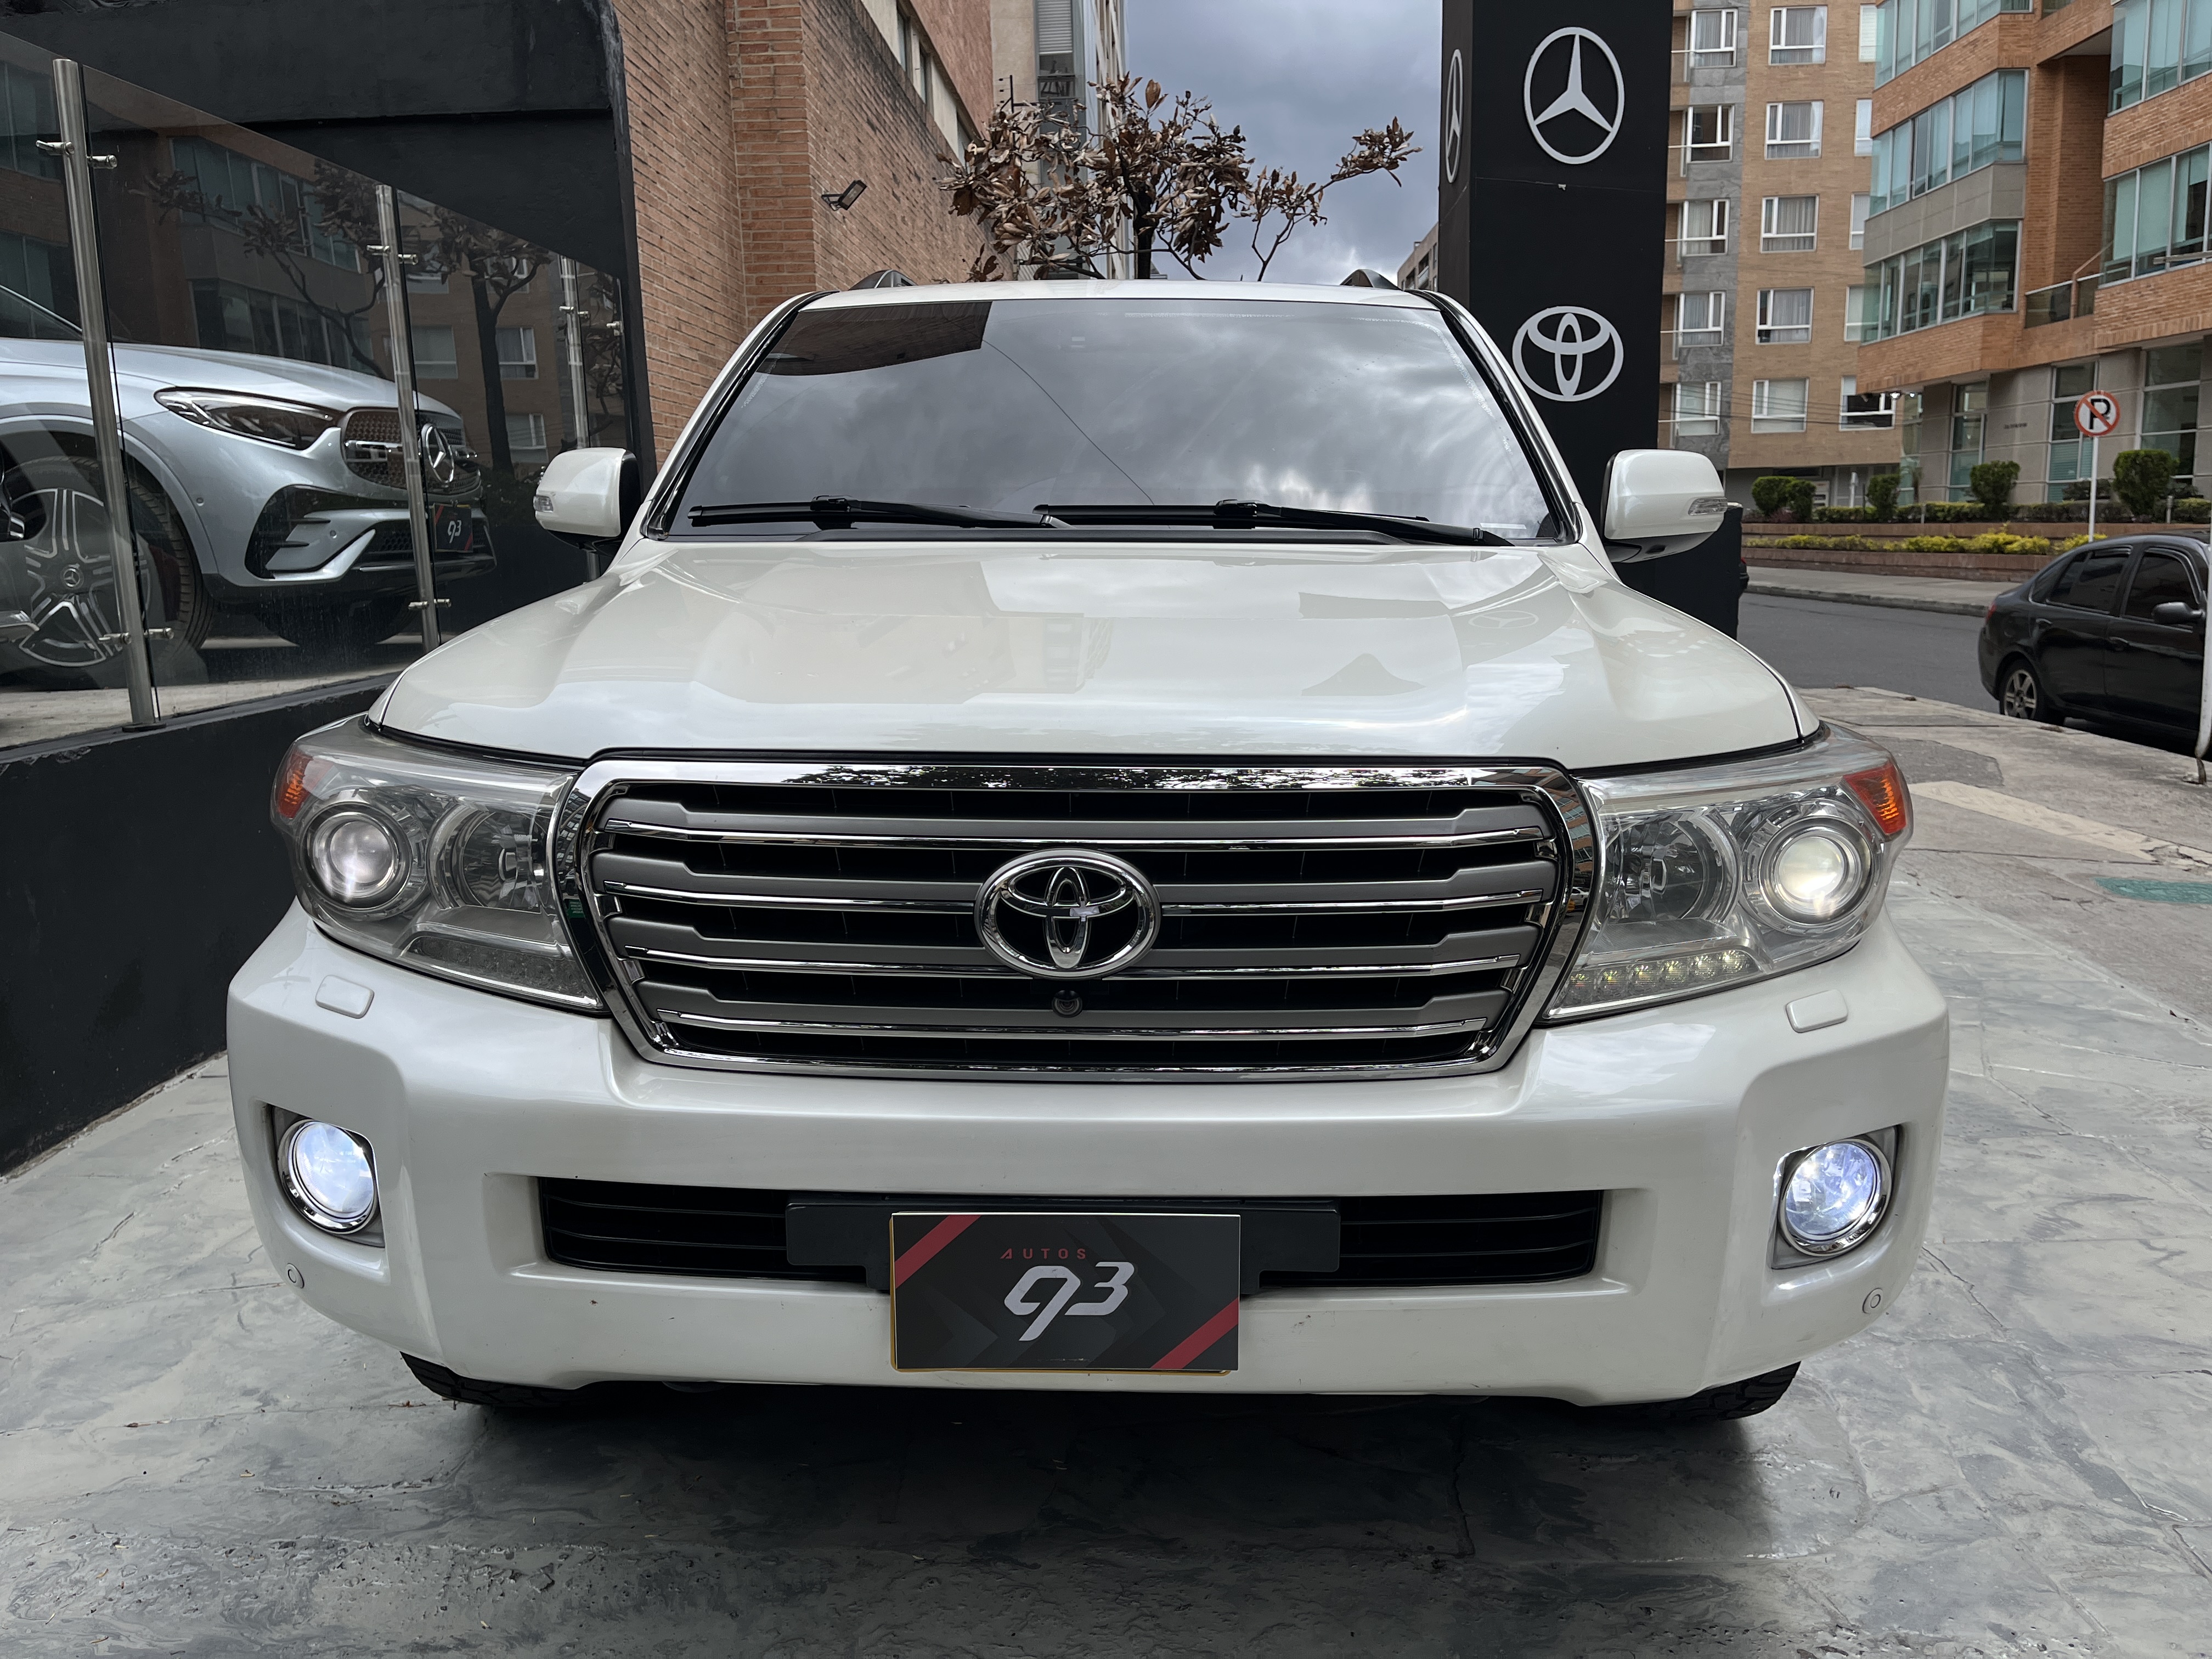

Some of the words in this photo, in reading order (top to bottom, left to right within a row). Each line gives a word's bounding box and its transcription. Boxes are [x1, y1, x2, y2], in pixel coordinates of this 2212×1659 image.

[447, 520, 462, 544] 93
[1000, 1248, 1087, 1260] AUTOS
[1003, 1261, 1135, 1341] 93
